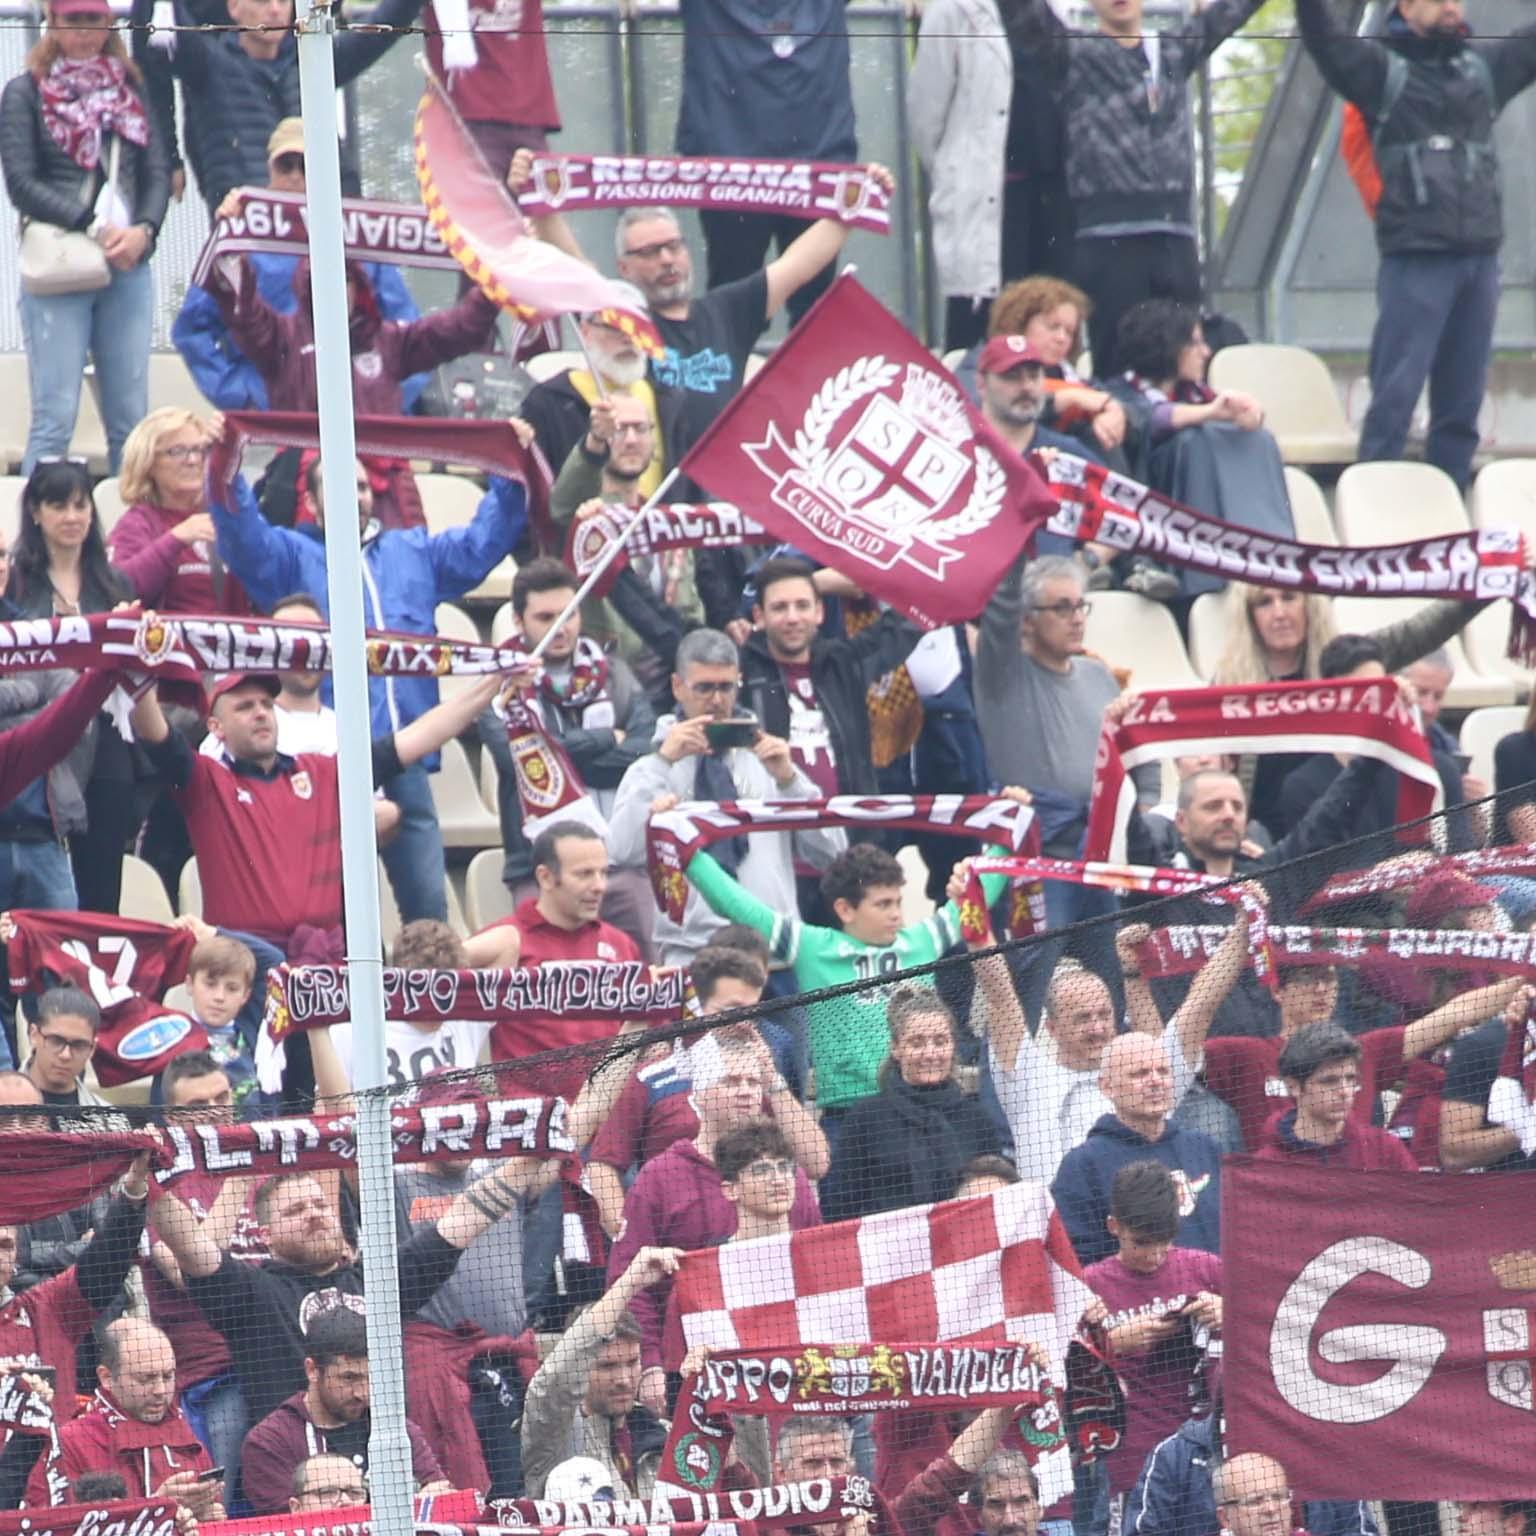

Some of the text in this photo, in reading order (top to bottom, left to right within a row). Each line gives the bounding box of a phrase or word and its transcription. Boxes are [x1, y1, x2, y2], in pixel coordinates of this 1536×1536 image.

[786, 488, 885, 556] CURVA SUD
[1268, 1234, 1449, 1426] G
